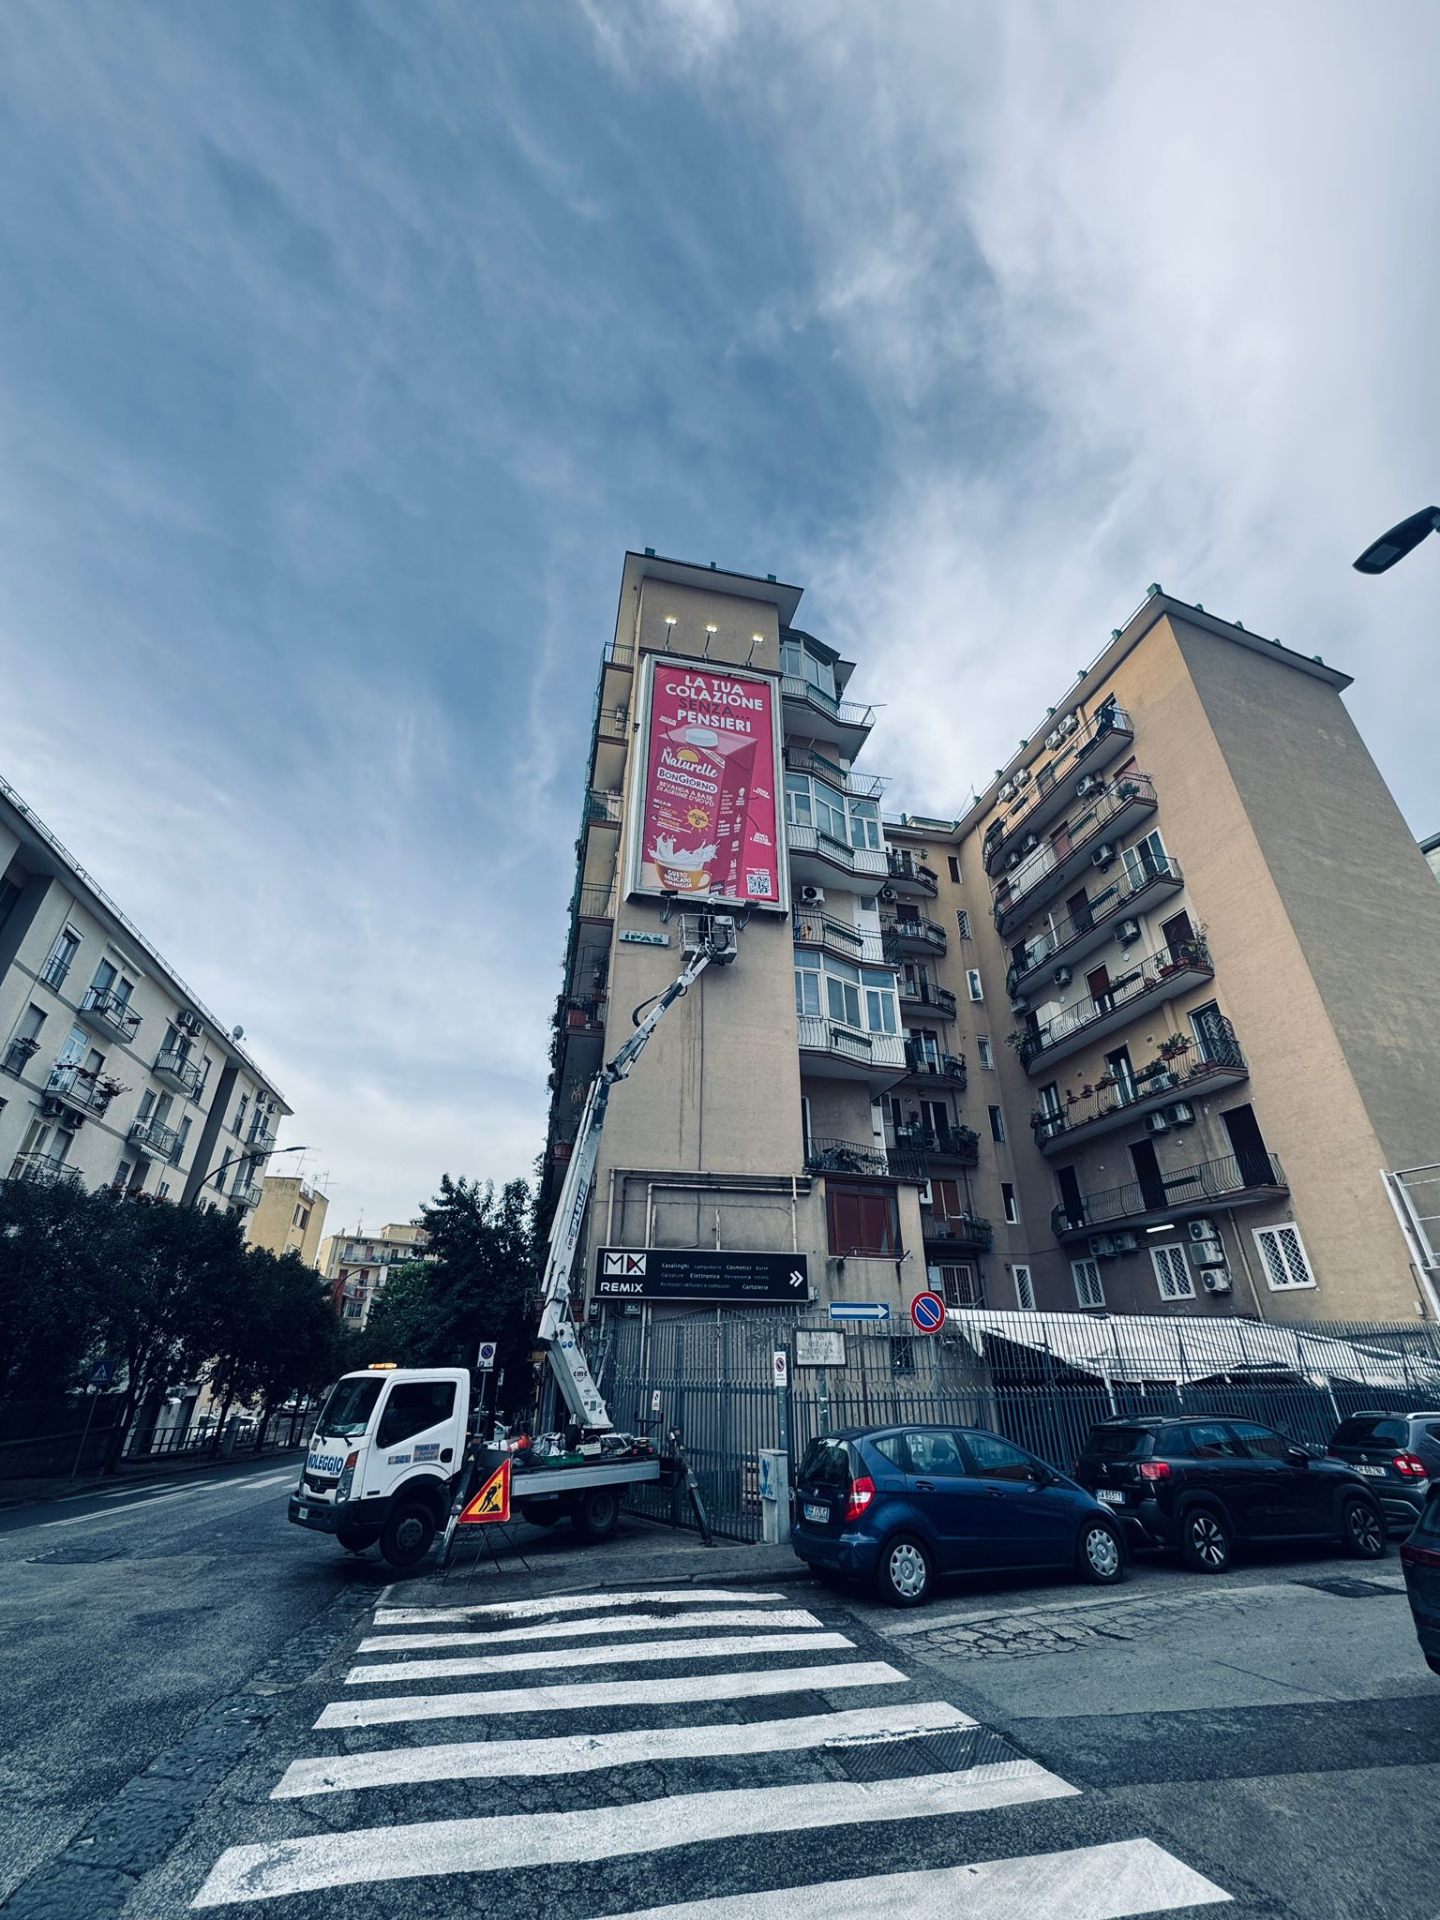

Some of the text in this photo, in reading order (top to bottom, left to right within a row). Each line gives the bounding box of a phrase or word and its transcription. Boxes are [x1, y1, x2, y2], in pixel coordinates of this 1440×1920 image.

[684, 675, 744, 696] LA TUA
[665, 684, 763, 711] COLAZIONE
[677, 710, 751, 733] PENSIERI
[660, 748, 718, 778] Naturelle
[600, 1282, 644, 1292] REMIX
[308, 1453, 344, 1471] NOLEGGIO
